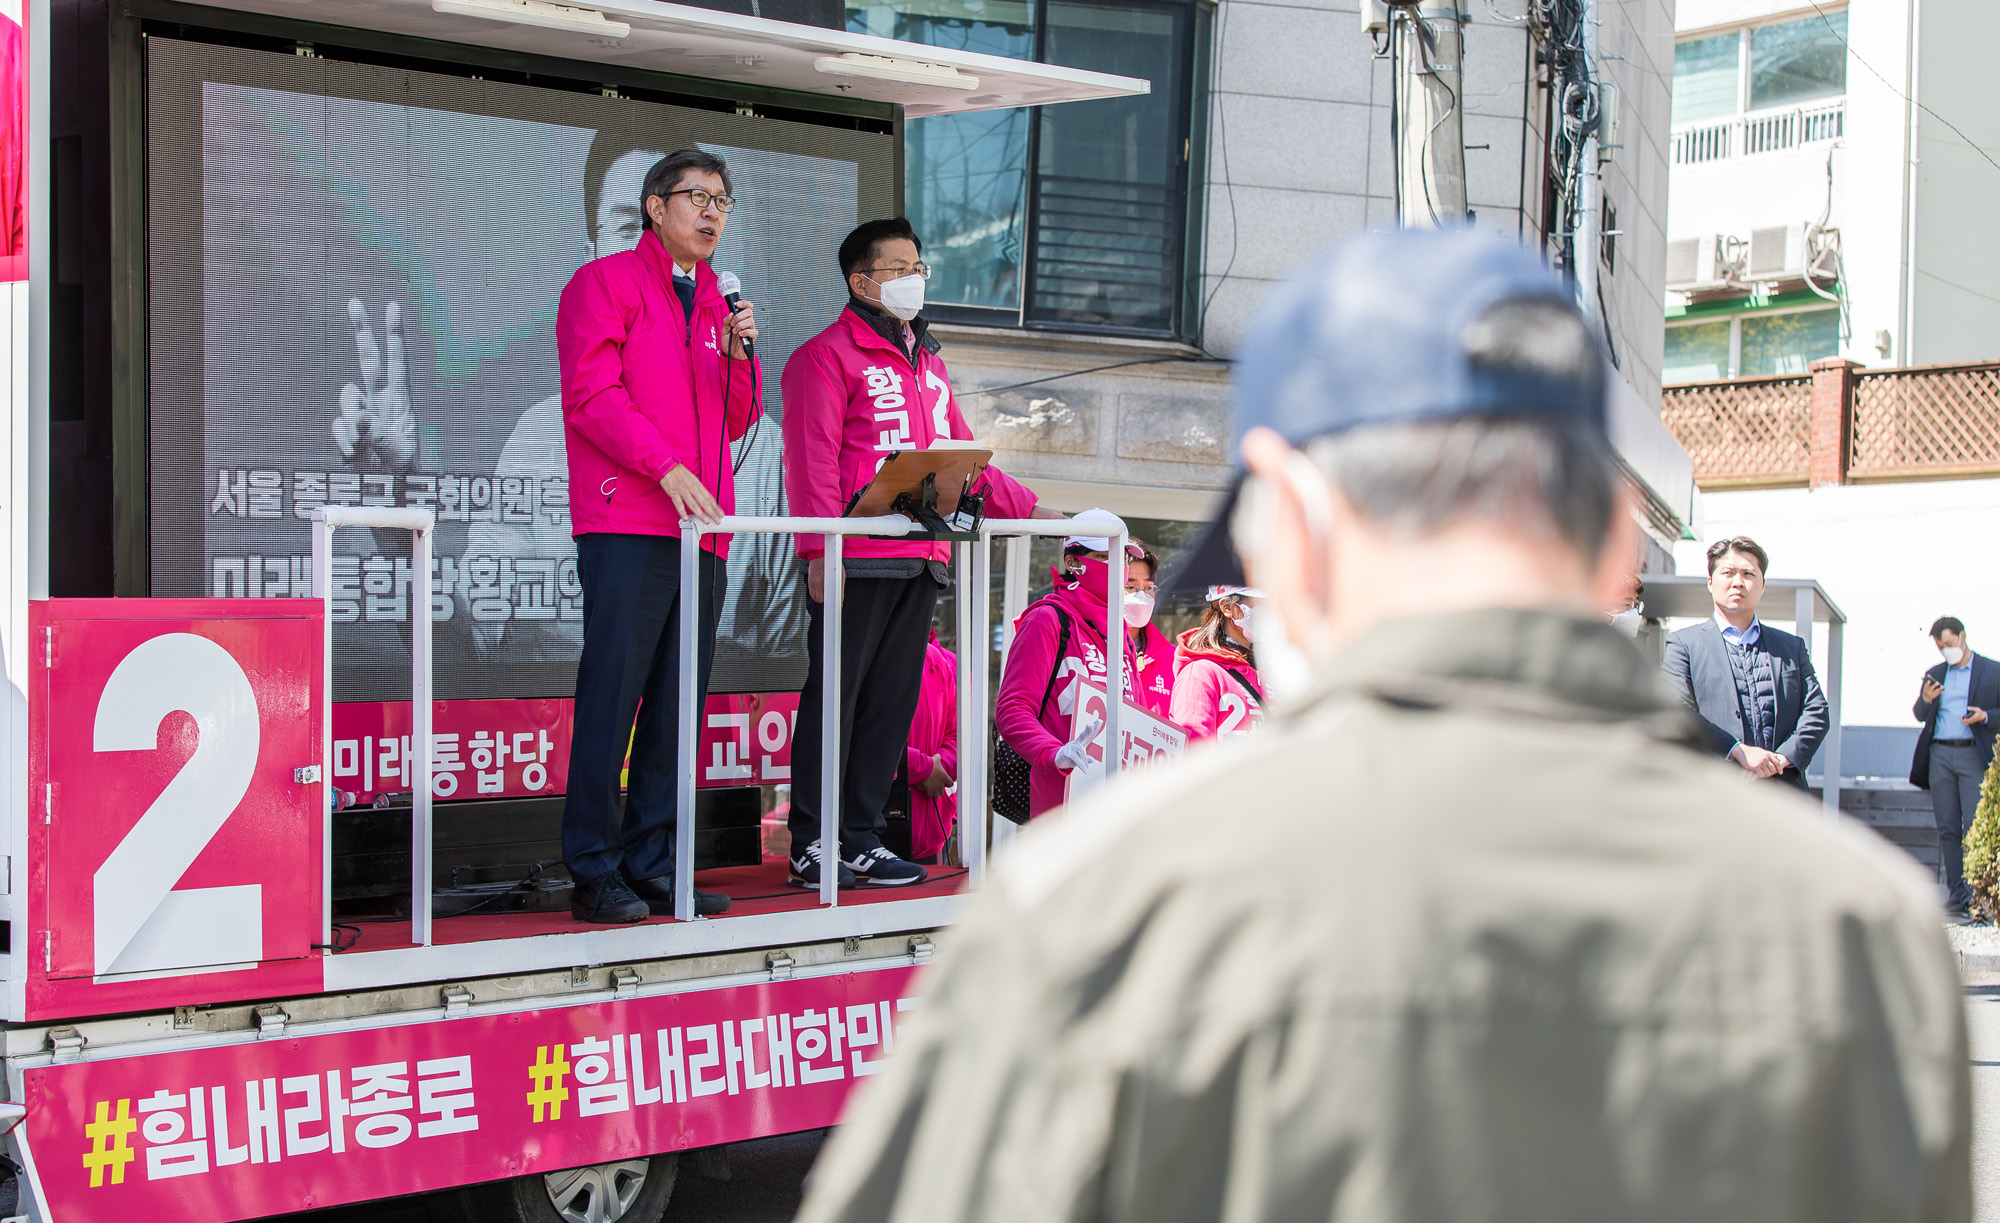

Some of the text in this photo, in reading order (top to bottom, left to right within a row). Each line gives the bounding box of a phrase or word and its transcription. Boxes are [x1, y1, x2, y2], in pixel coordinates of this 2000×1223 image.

[862, 365, 917, 475] 황교
[925, 368, 951, 440] 2
[211, 470, 282, 518] 서울
[405, 475, 533, 523] 국회의원
[93, 632, 263, 985] 2
[334, 730, 554, 797] 미래통합당
[82, 1054, 480, 1188] #힘내라종로
